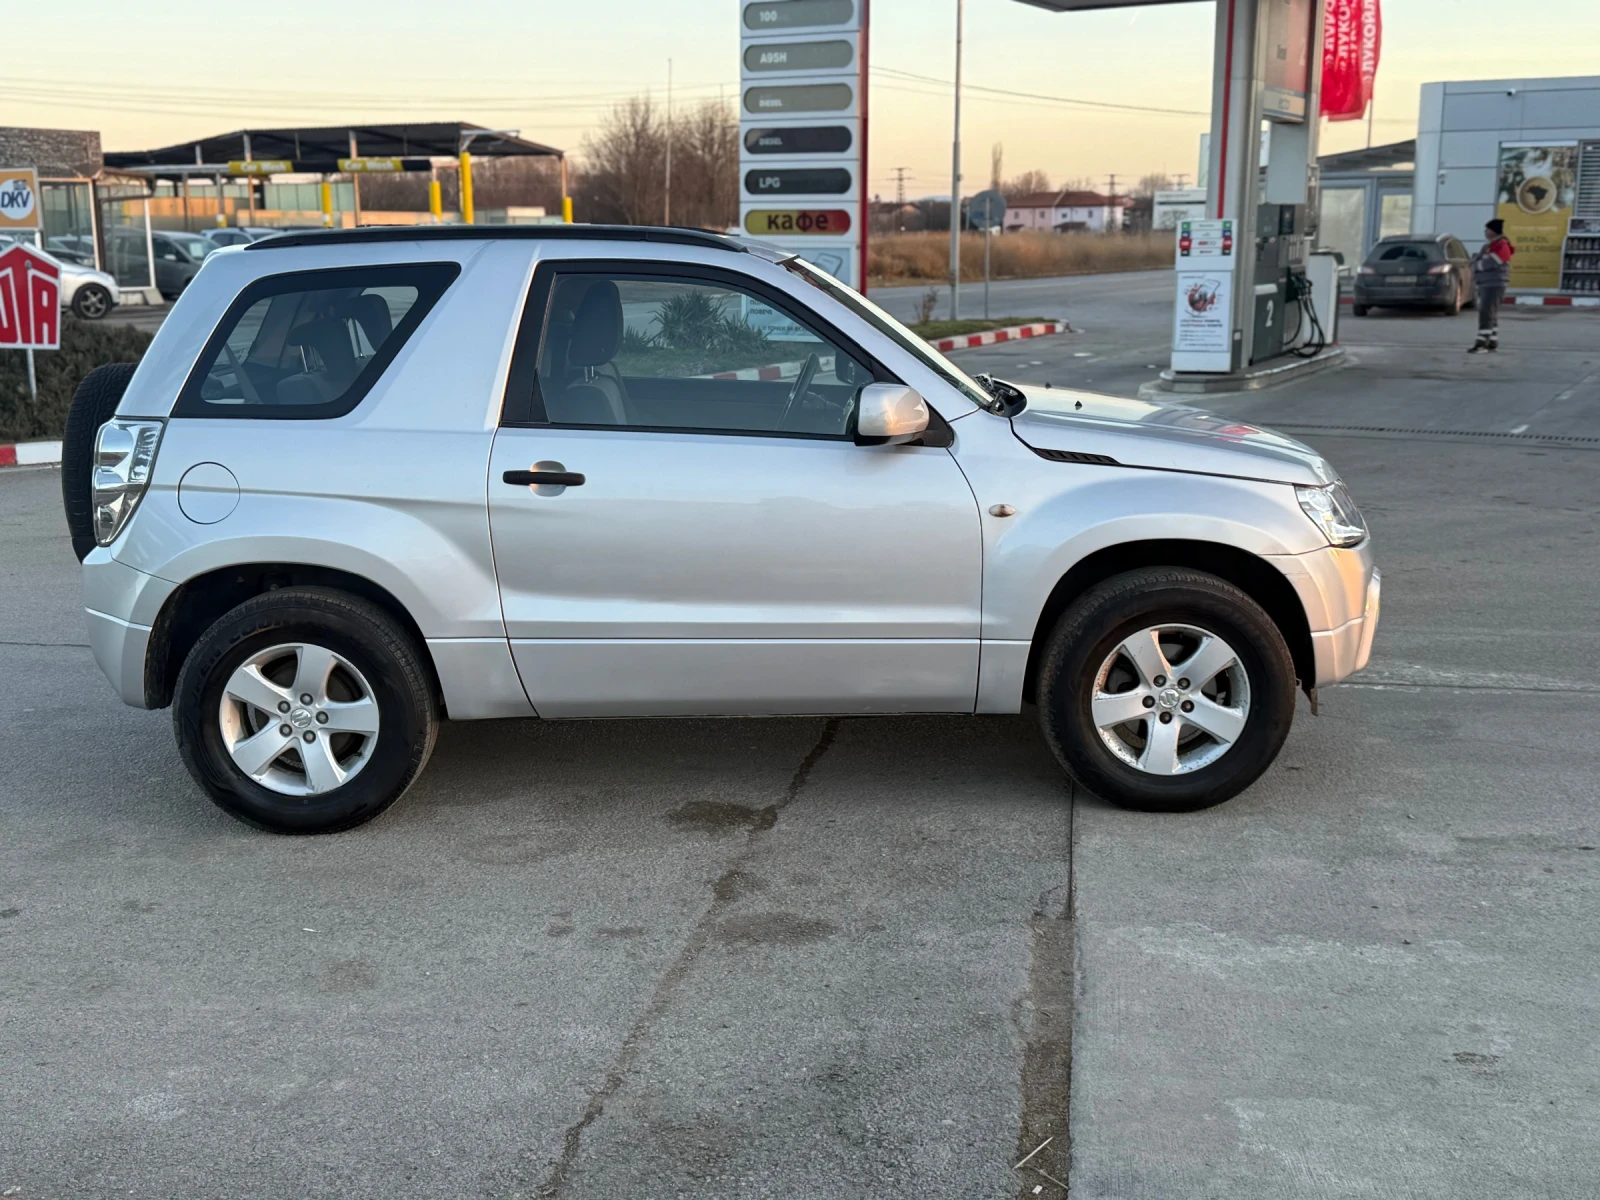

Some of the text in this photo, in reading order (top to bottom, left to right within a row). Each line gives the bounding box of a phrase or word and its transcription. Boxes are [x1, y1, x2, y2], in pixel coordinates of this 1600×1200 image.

[759, 10, 778, 22] 100
[759, 177, 780, 188] LPG
[1, 191, 30, 208] DKV
[767, 212, 828, 232] кафе
[1265, 300, 1274, 327] 2
